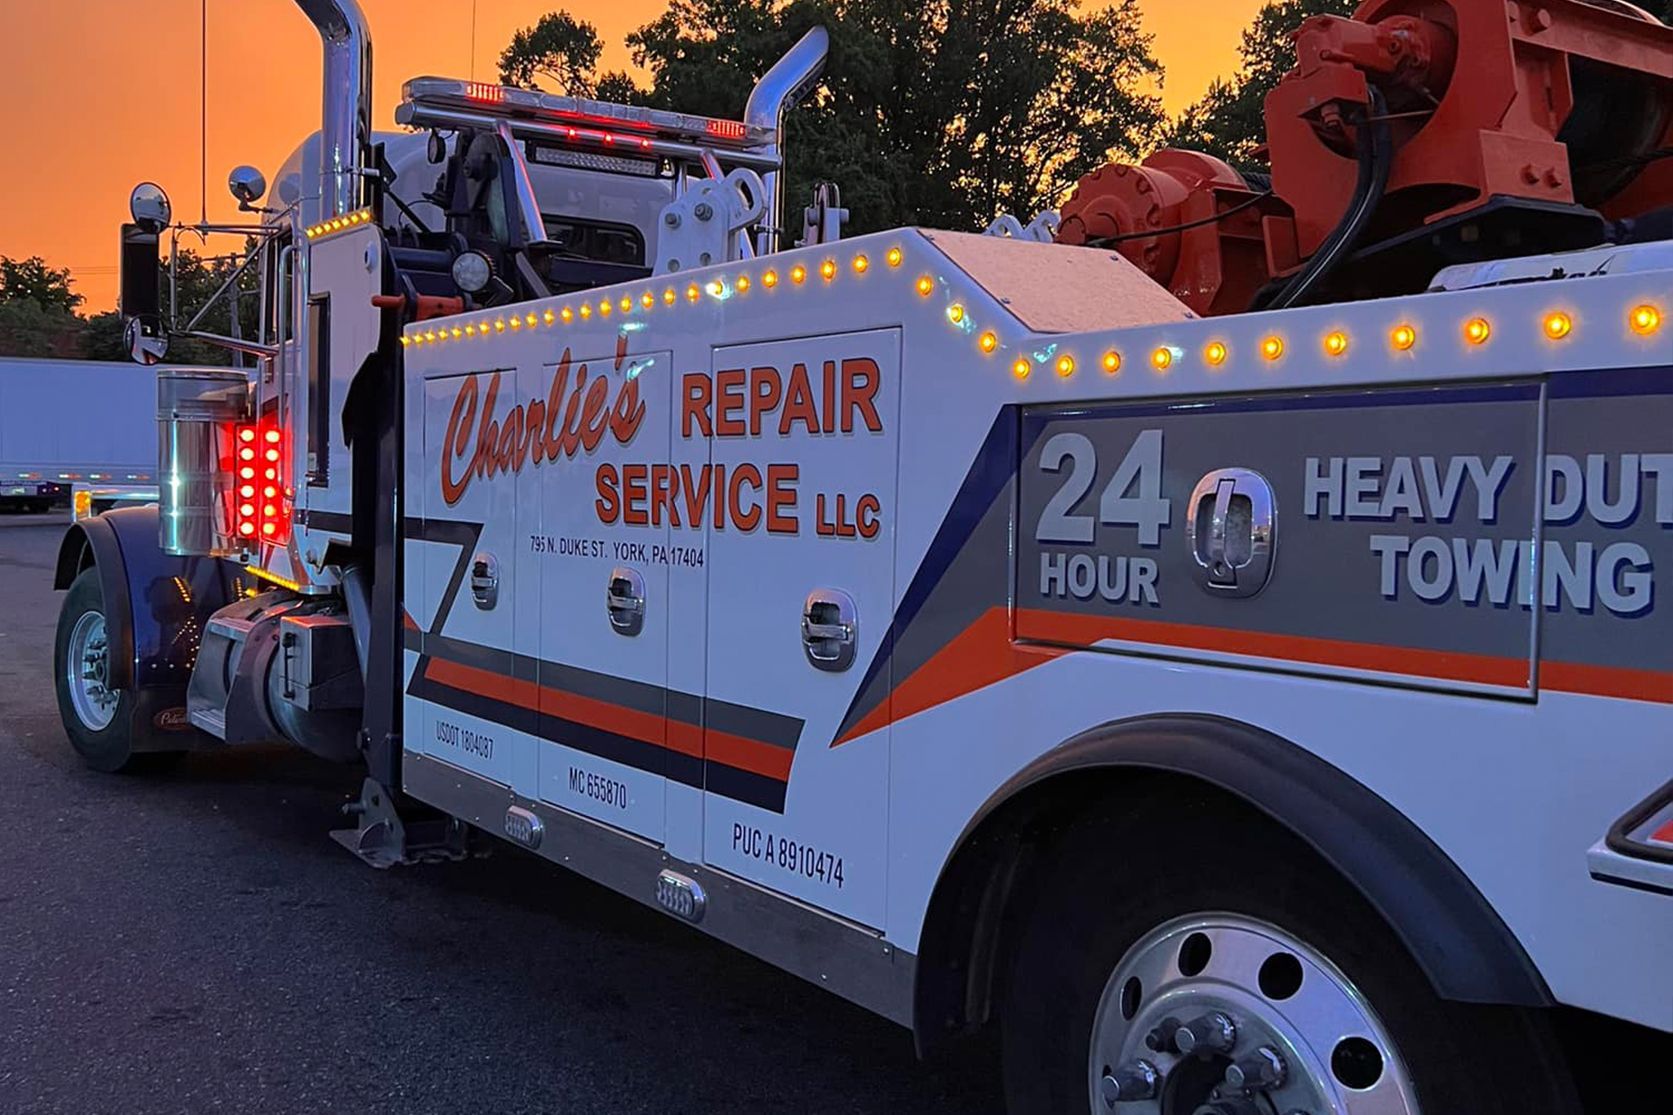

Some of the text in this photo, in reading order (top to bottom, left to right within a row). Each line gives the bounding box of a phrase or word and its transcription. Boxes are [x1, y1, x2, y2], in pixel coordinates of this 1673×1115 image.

[441, 334, 645, 505] Charlie's
[682, 358, 882, 438] REPAIR
[596, 463, 881, 538] SERVICE LLC
[1036, 429, 1673, 546] 24 HEAVY DUT
[548, 537, 557, 553] N.
[559, 537, 589, 557] DUKE
[591, 540, 608, 558] ST.
[613, 542, 650, 566] YORK,
[652, 545, 669, 565] PA
[670, 547, 704, 567] 17404
[1039, 535, 1655, 619] HOUR TOWING
[436, 720, 459, 747] USDOT
[569, 766, 626, 809] MC 655870
[733, 822, 844, 889] PUC A 8910474
